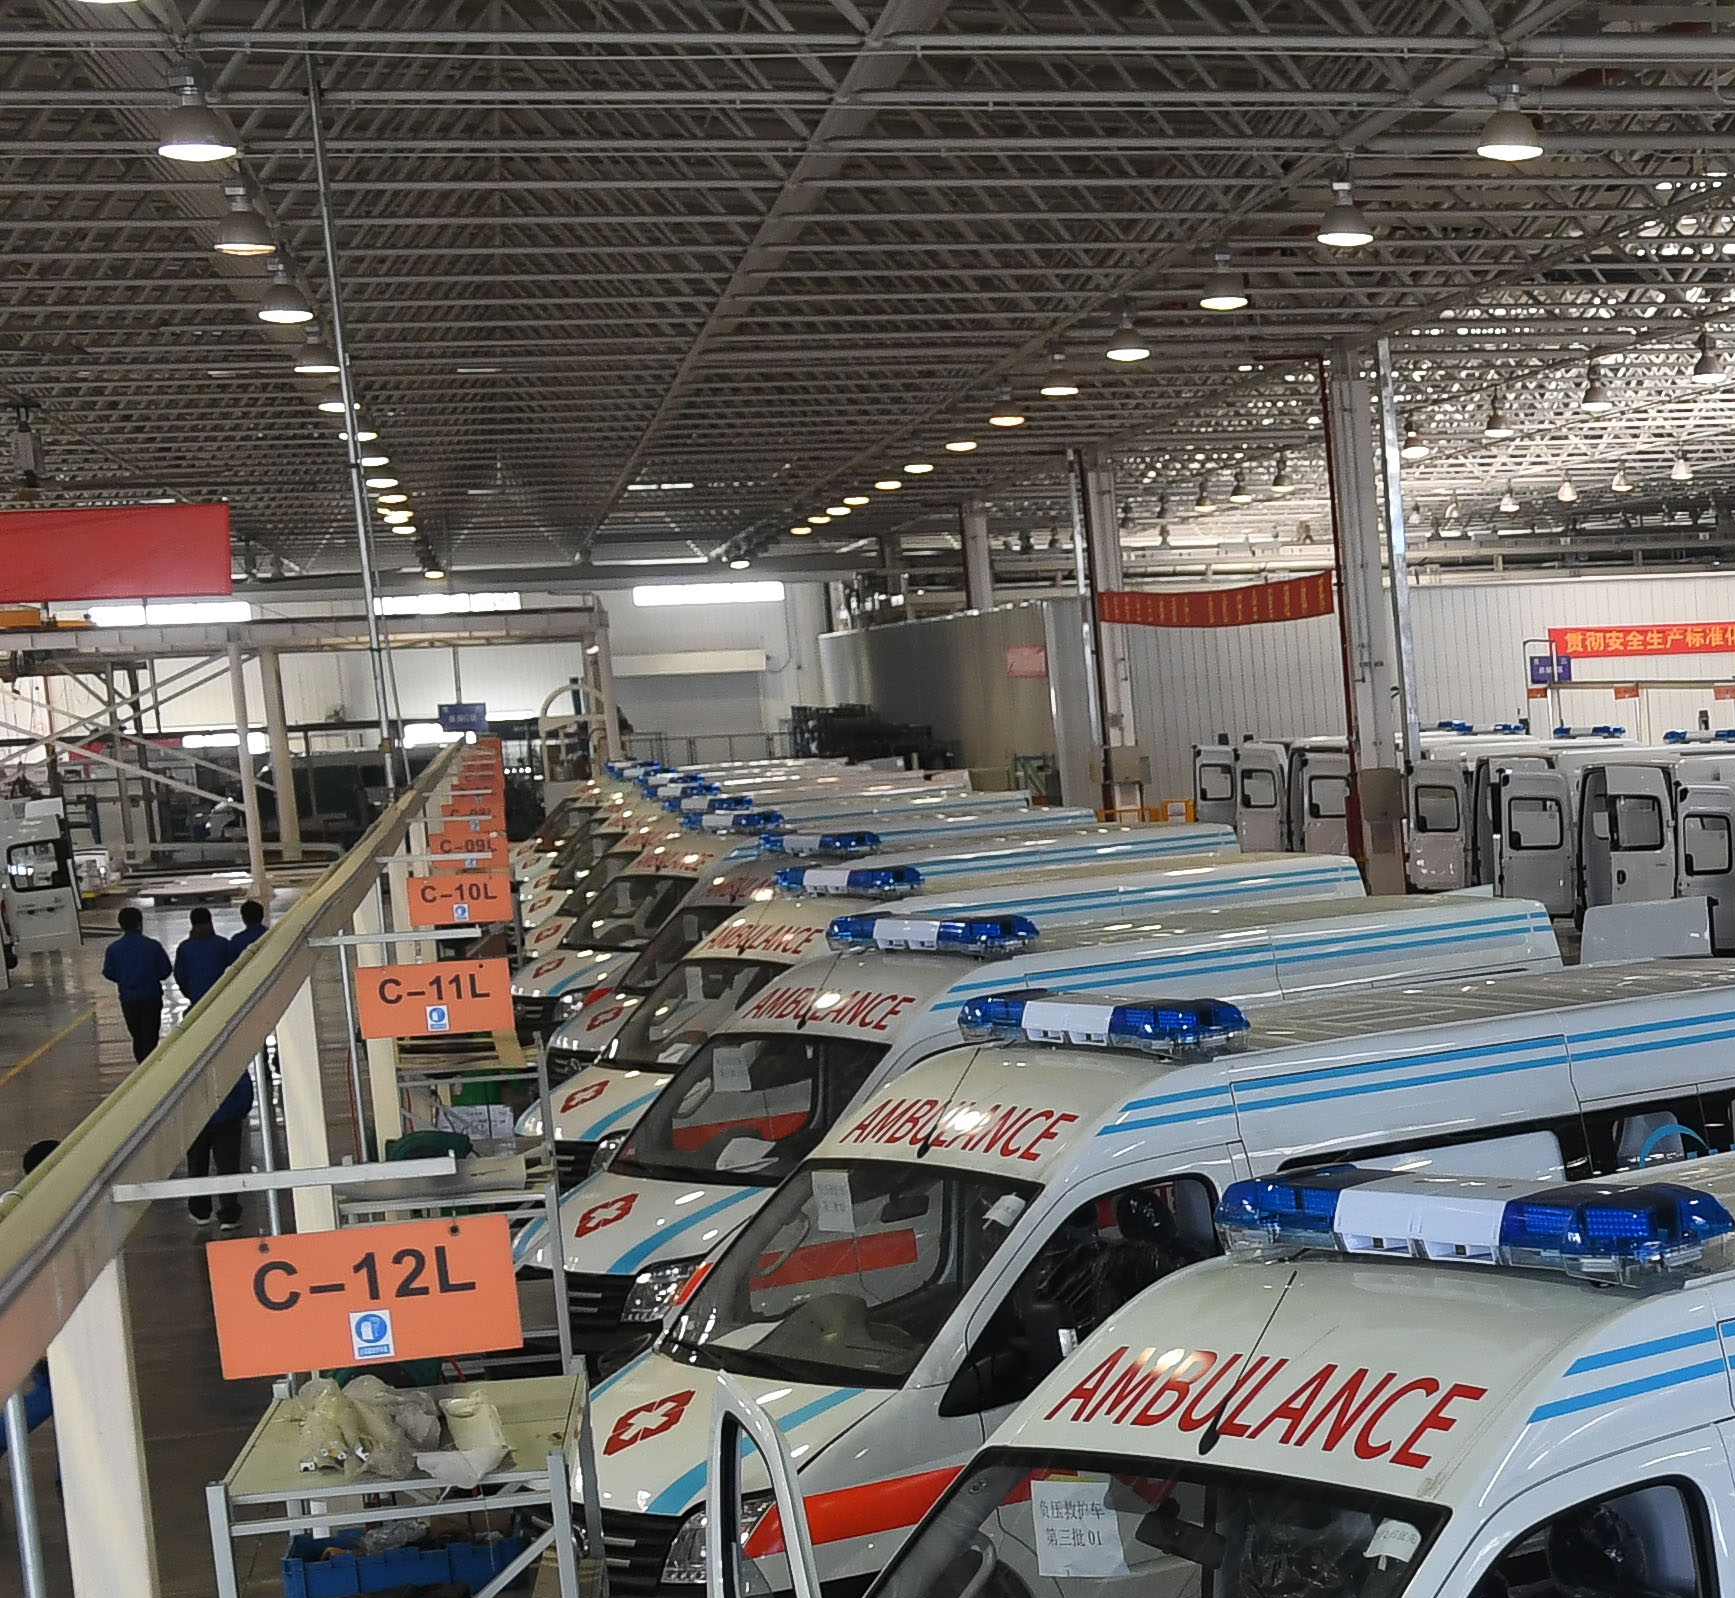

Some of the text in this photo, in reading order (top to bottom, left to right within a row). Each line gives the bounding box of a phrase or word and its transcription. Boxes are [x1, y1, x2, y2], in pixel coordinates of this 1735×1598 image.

[420, 883, 498, 904] C-10L
[702, 925, 824, 956] AMBULANCE
[378, 970, 491, 1007] C-11L
[744, 988, 916, 1031] AMBULANCE
[840, 1098, 1080, 1162] AMBULANCE
[252, 1243, 478, 1312] C-12L
[1046, 1346, 1487, 1470] AMBULANCE
[1046, 1528, 1102, 1548] 第三批 01
